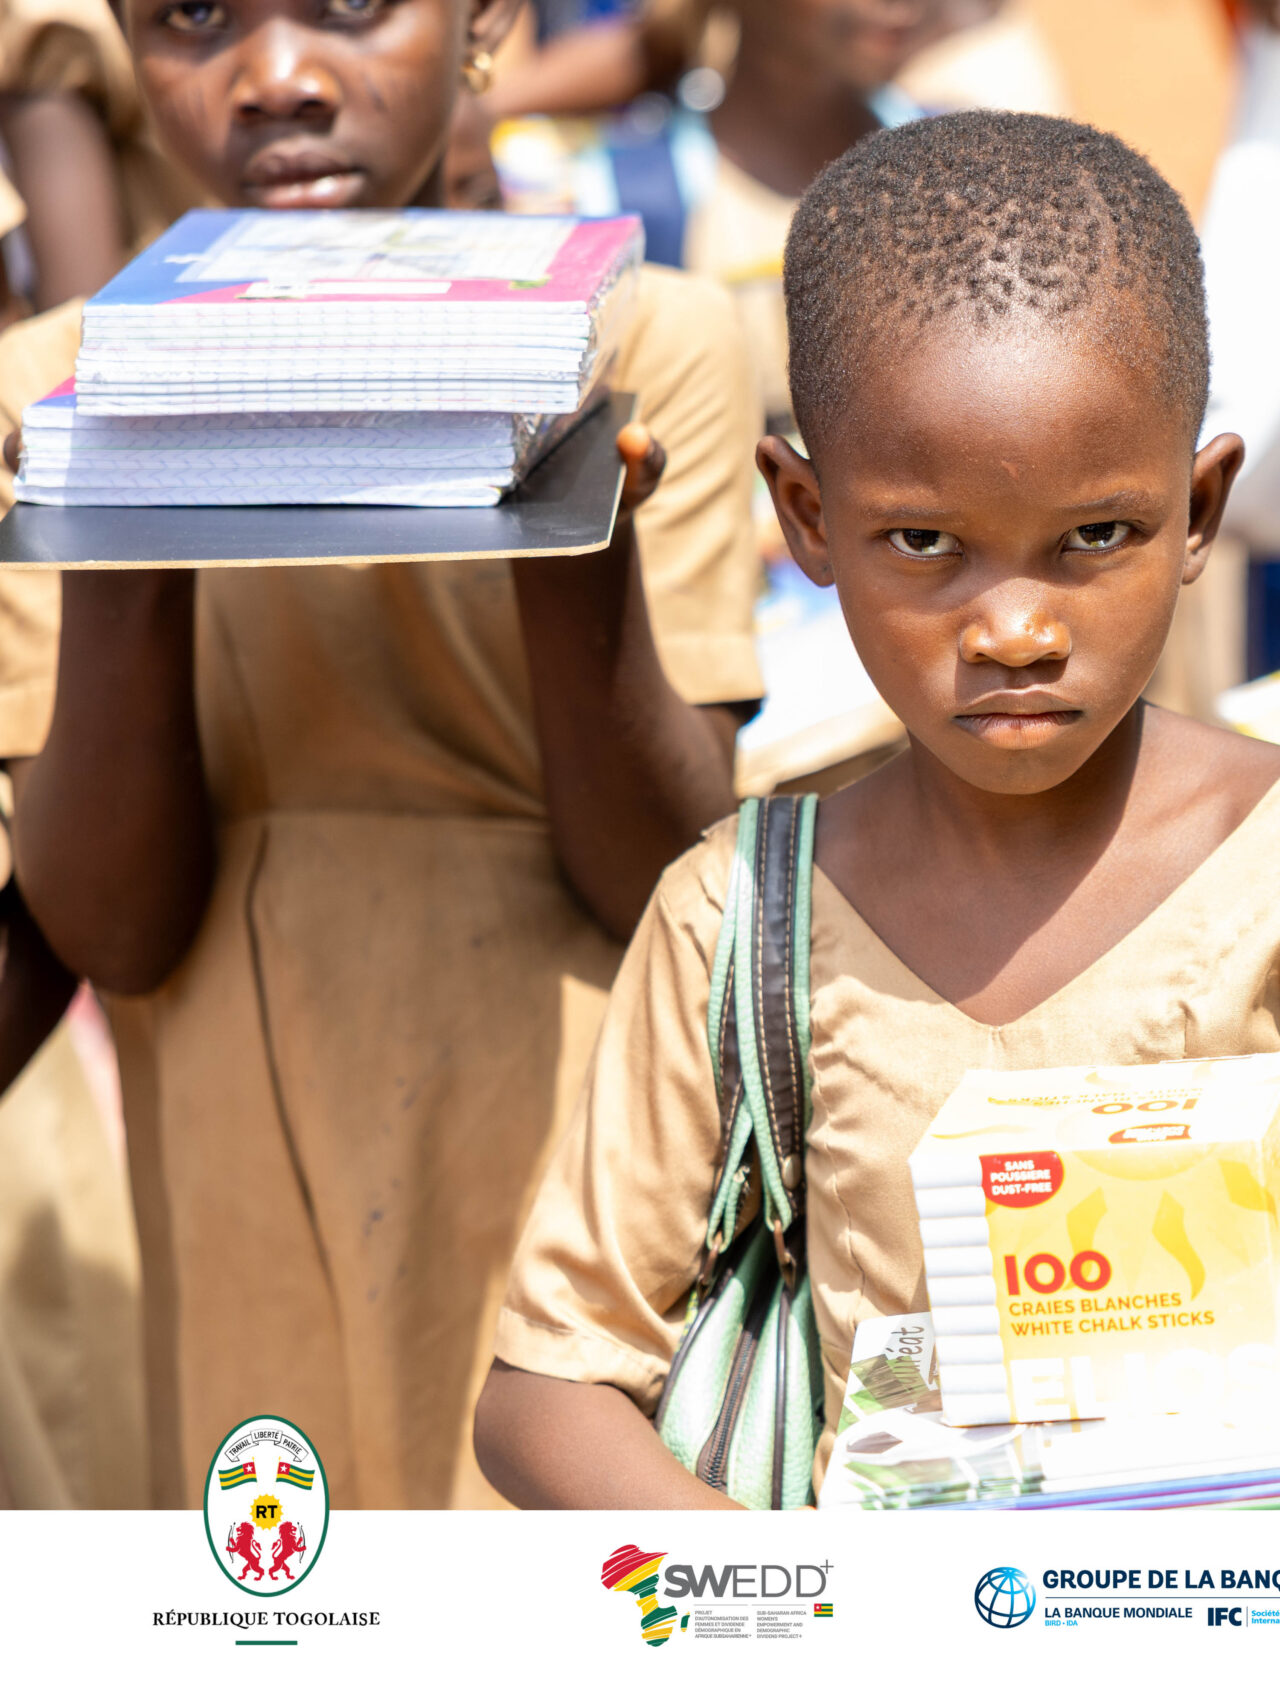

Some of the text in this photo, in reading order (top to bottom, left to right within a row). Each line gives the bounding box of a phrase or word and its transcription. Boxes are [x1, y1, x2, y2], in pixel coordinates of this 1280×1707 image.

[1091, 1098, 1198, 1115] 100
[1004, 1160, 1035, 1171] SANS
[991, 1182, 1053, 1196] DUST-FREE
[1004, 1250, 1112, 1296] 100
[1009, 1292, 1182, 1317] CRAIES BLANCHES
[1010, 1310, 1216, 1336] WHITE CHALK STICKS
